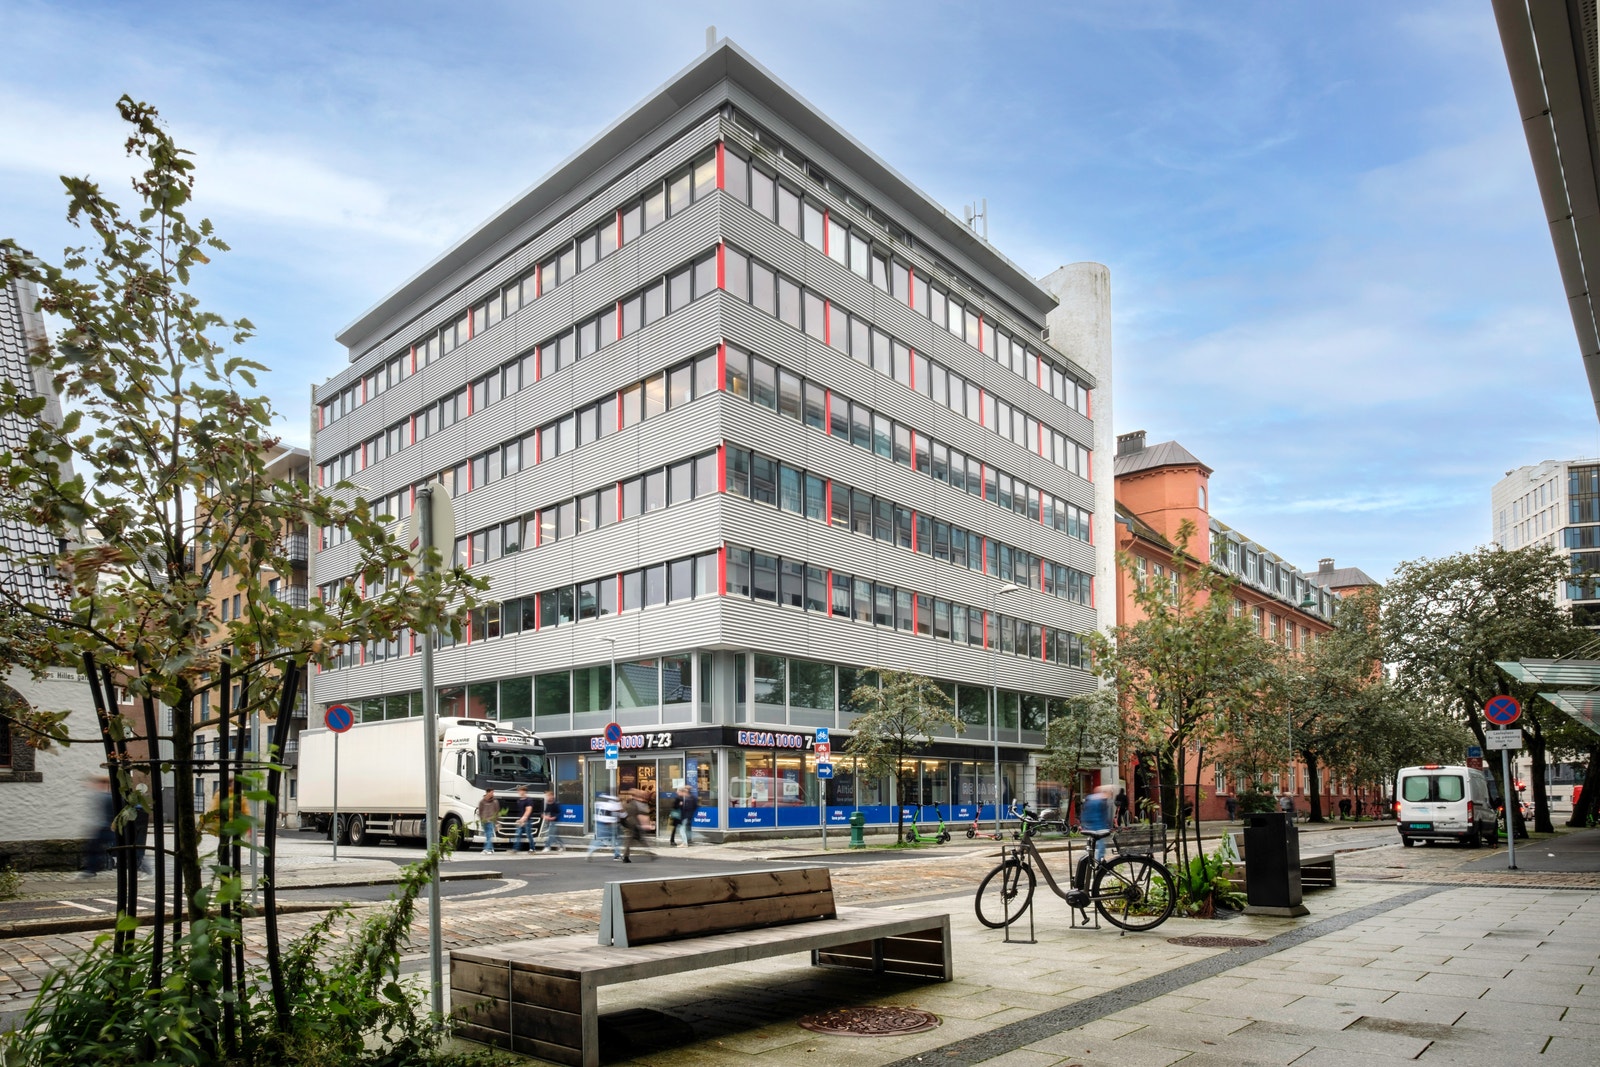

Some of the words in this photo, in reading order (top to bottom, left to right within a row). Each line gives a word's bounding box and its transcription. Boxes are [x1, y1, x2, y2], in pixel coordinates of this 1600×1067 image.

[57, 671, 74, 680] Hilles
[591, 736, 620, 750] RE
[620, 734, 644, 749] 1000
[646, 732, 672, 748] 7-23
[738, 730, 775, 746] REMA
[776, 734, 802, 748] 1000
[804, 736, 816, 749] 7-
